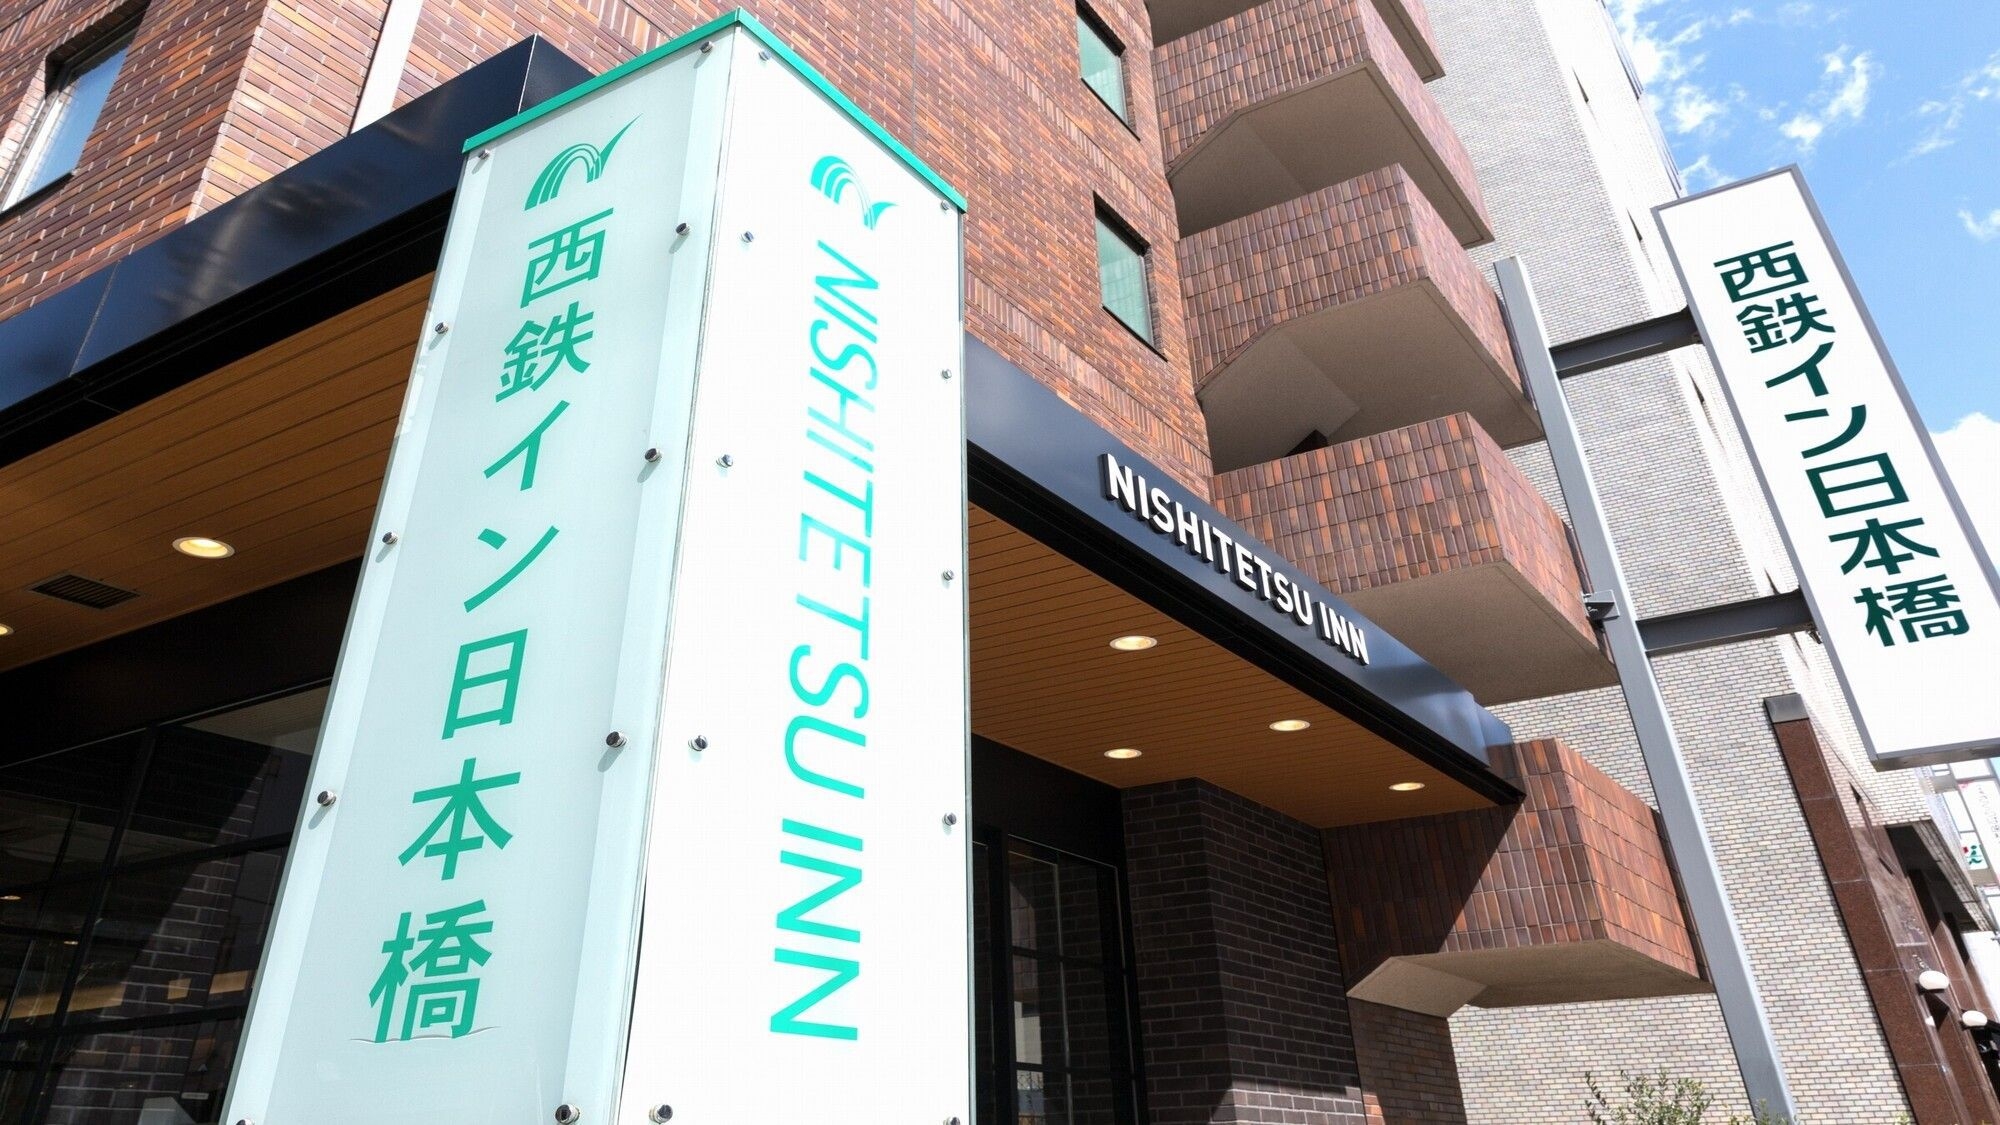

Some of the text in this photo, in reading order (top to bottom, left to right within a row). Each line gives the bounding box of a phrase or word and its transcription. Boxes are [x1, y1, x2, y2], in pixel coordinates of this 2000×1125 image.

[369, 207, 614, 1044] 西鉄イン日本橋
[770, 240, 880, 1041] NISHITETSU INN
[1103, 453, 1370, 665] NISHITETSU INN
[1713, 240, 1970, 648] 西鉄イン日本橋
